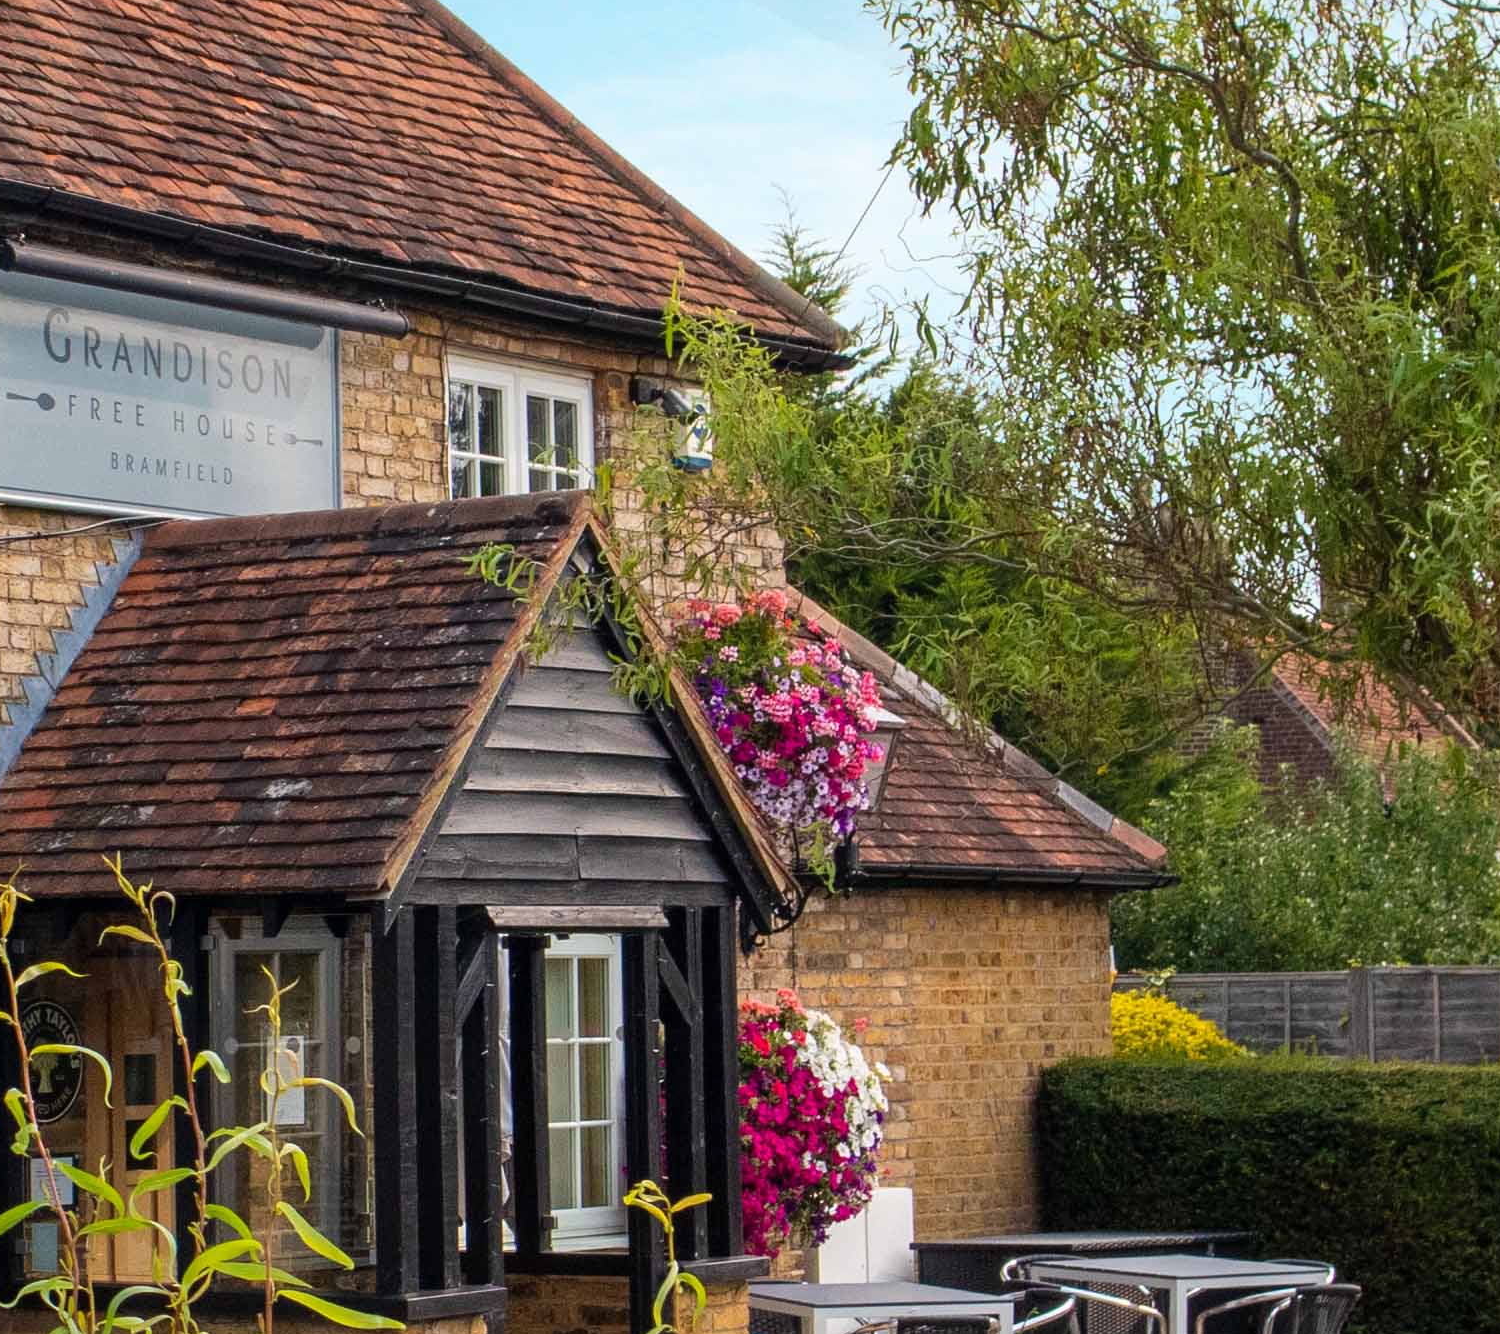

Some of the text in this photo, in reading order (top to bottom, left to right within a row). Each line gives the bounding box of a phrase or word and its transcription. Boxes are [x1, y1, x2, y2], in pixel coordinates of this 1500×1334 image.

[43, 306, 291, 399] GRANDISON
[68, 394, 276, 446] FREE HOUSE
[111, 451, 233, 485] BRAMFIELD
